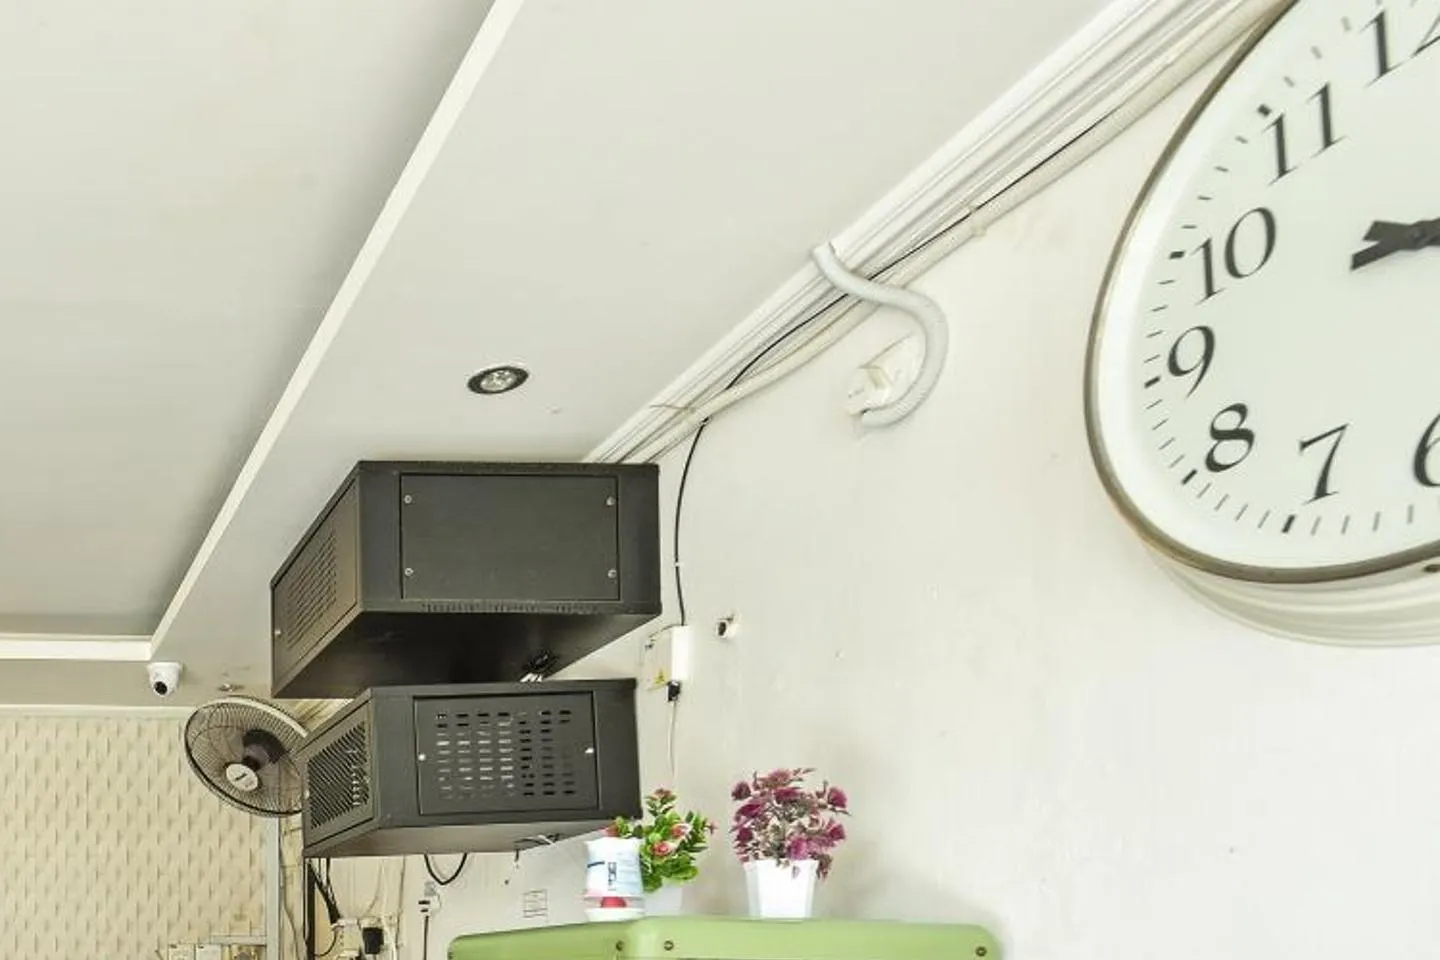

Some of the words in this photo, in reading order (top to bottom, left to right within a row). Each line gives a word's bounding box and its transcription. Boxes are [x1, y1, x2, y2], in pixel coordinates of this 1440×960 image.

[1262, 83, 1352, 185] 11
[1185, 207, 1276, 304] 10
[1167, 325, 1215, 398] 9
[1205, 402, 1254, 472] 8
[1299, 423, 1349, 503] 7
